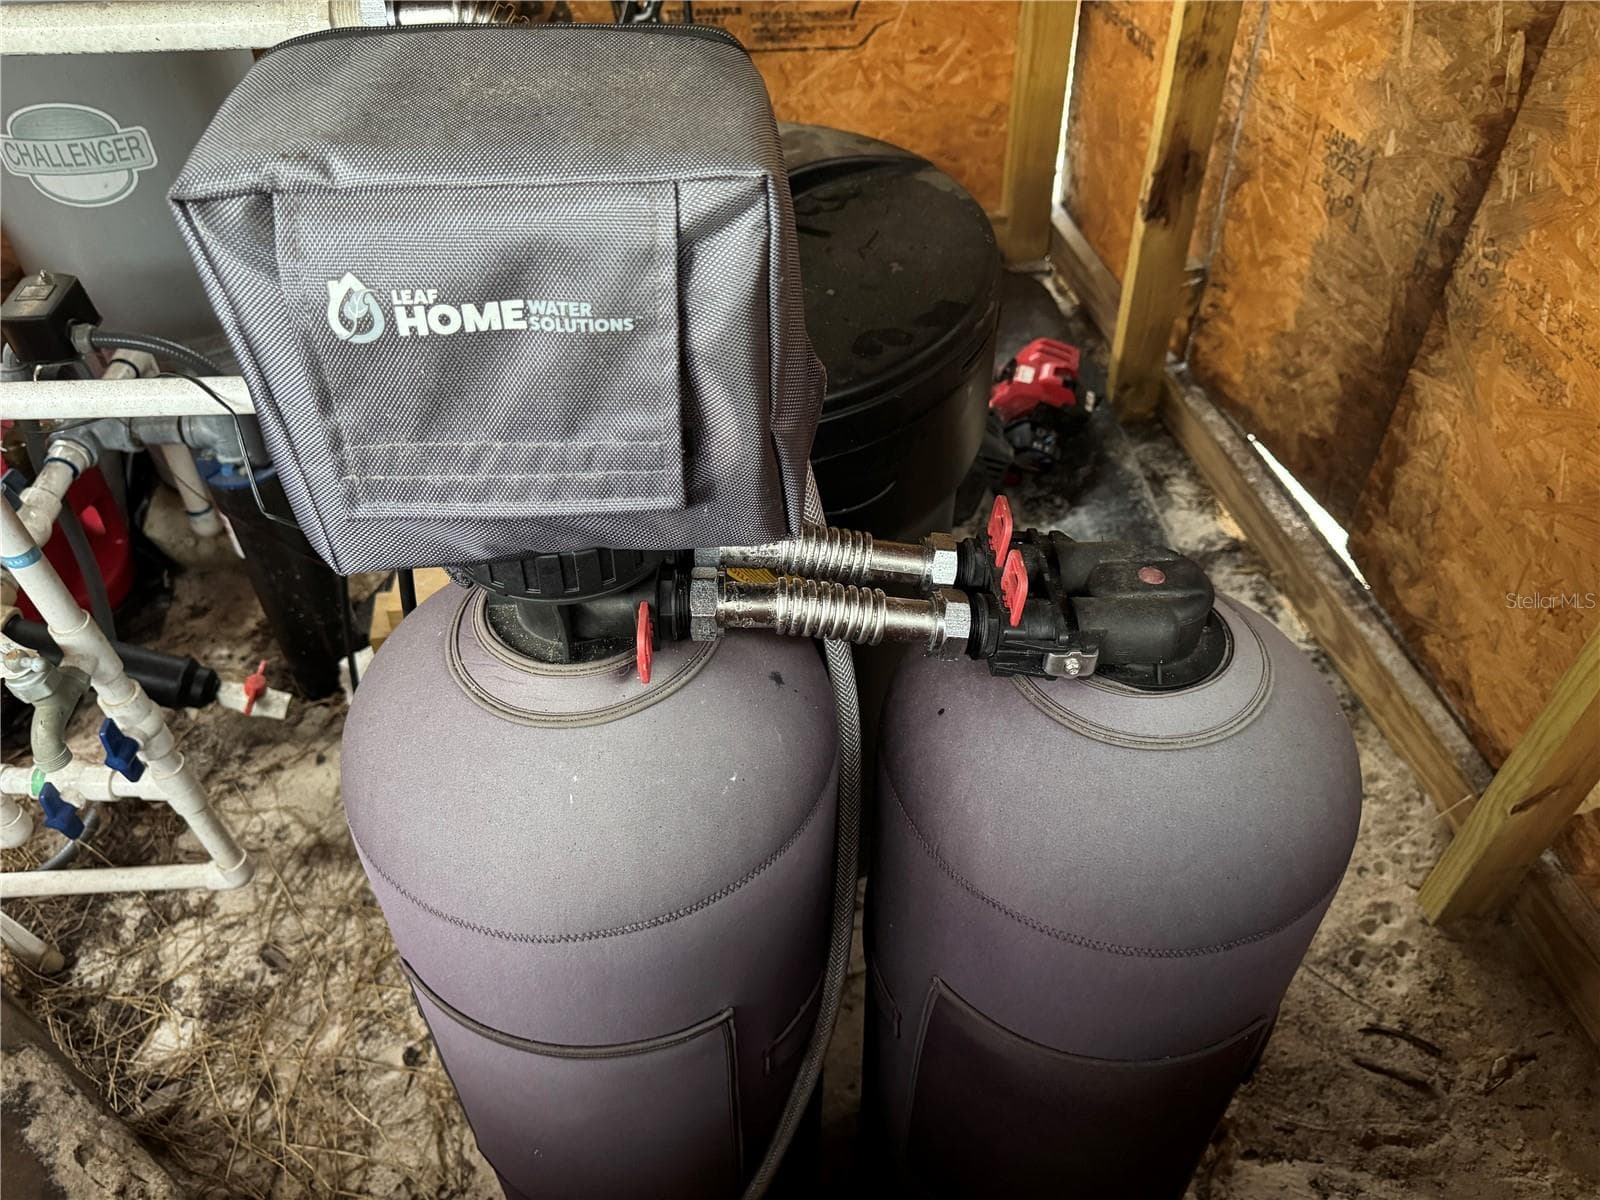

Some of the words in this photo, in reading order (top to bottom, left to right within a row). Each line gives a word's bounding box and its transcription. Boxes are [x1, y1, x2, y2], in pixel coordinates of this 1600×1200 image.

[4, 135, 145, 168] CHALLENGER
[391, 289, 438, 305] LEAF
[528, 300, 592, 318] WATER
[396, 300, 528, 337] HOME
[530, 317, 635, 334] SOLUTIONS
